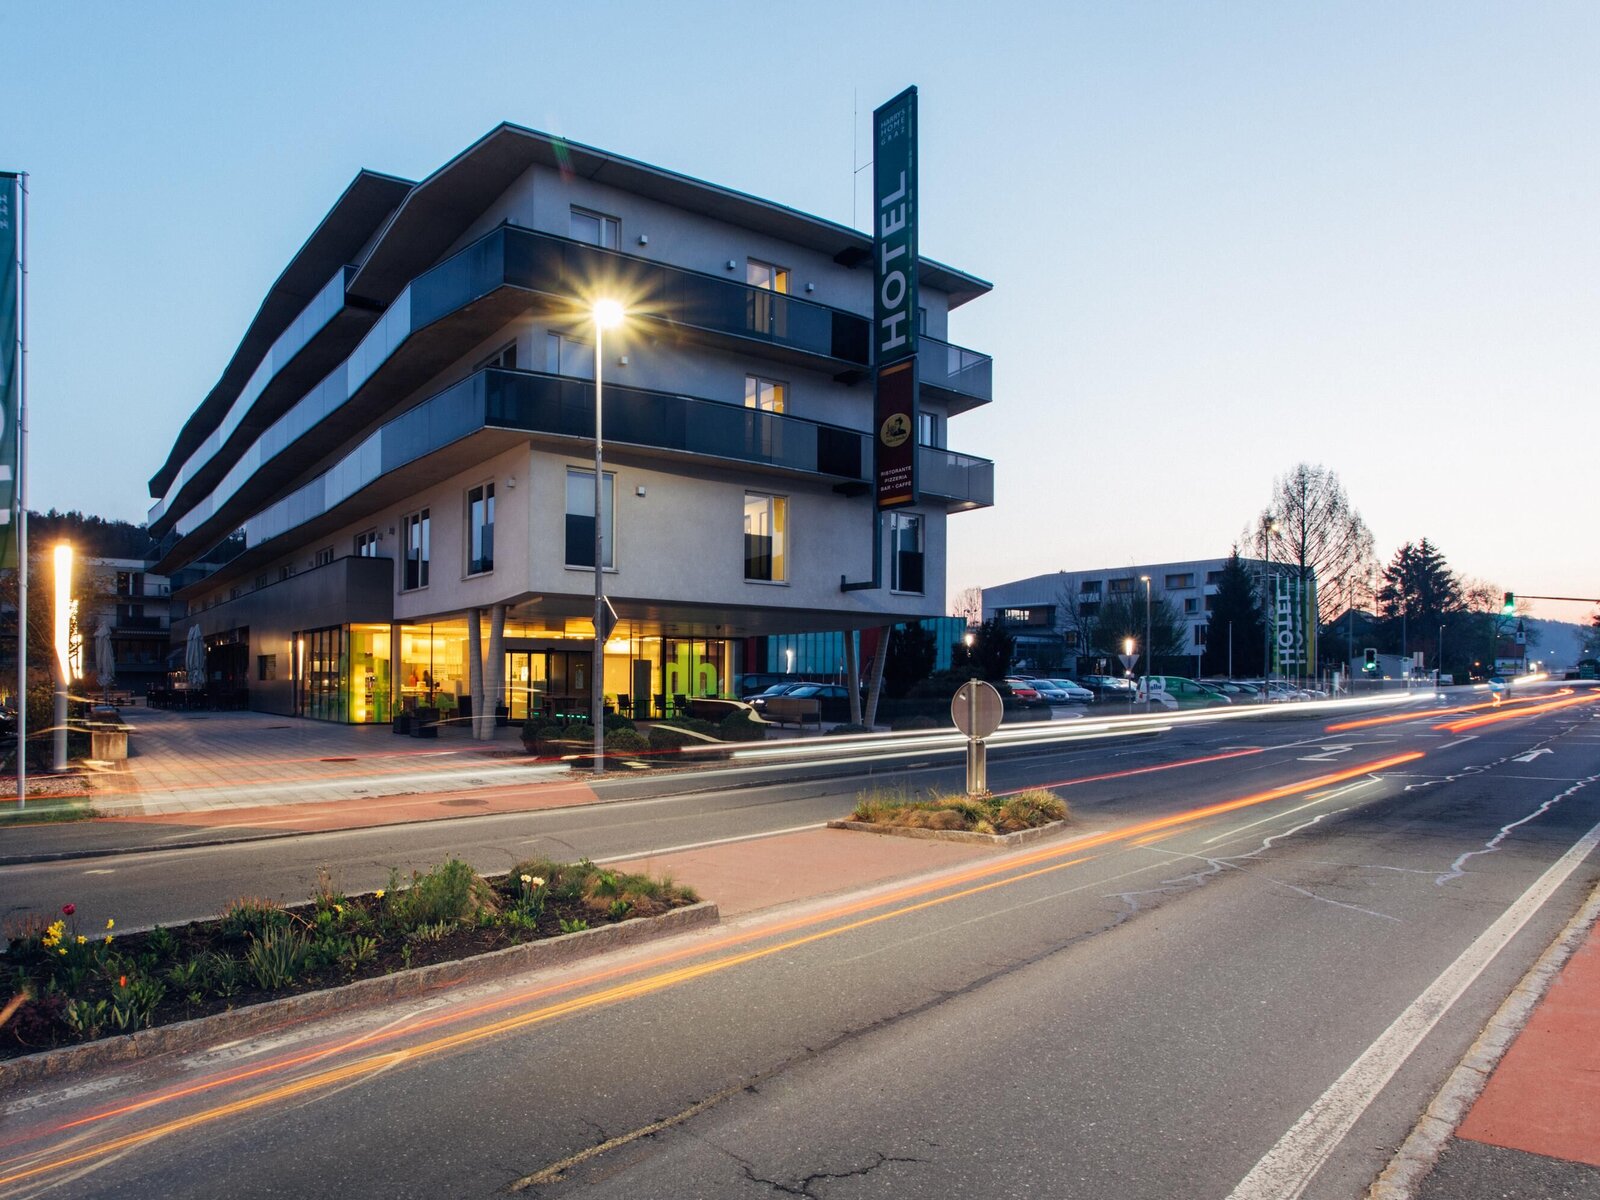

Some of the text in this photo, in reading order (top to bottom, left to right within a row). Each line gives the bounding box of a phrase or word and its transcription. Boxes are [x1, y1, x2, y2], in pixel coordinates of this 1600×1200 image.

[880, 116, 904, 138] HOME
[881, 170, 906, 352] HOTEL
[880, 465, 912, 477] RISTORANTE
[884, 474, 908, 484] PIZZERIA
